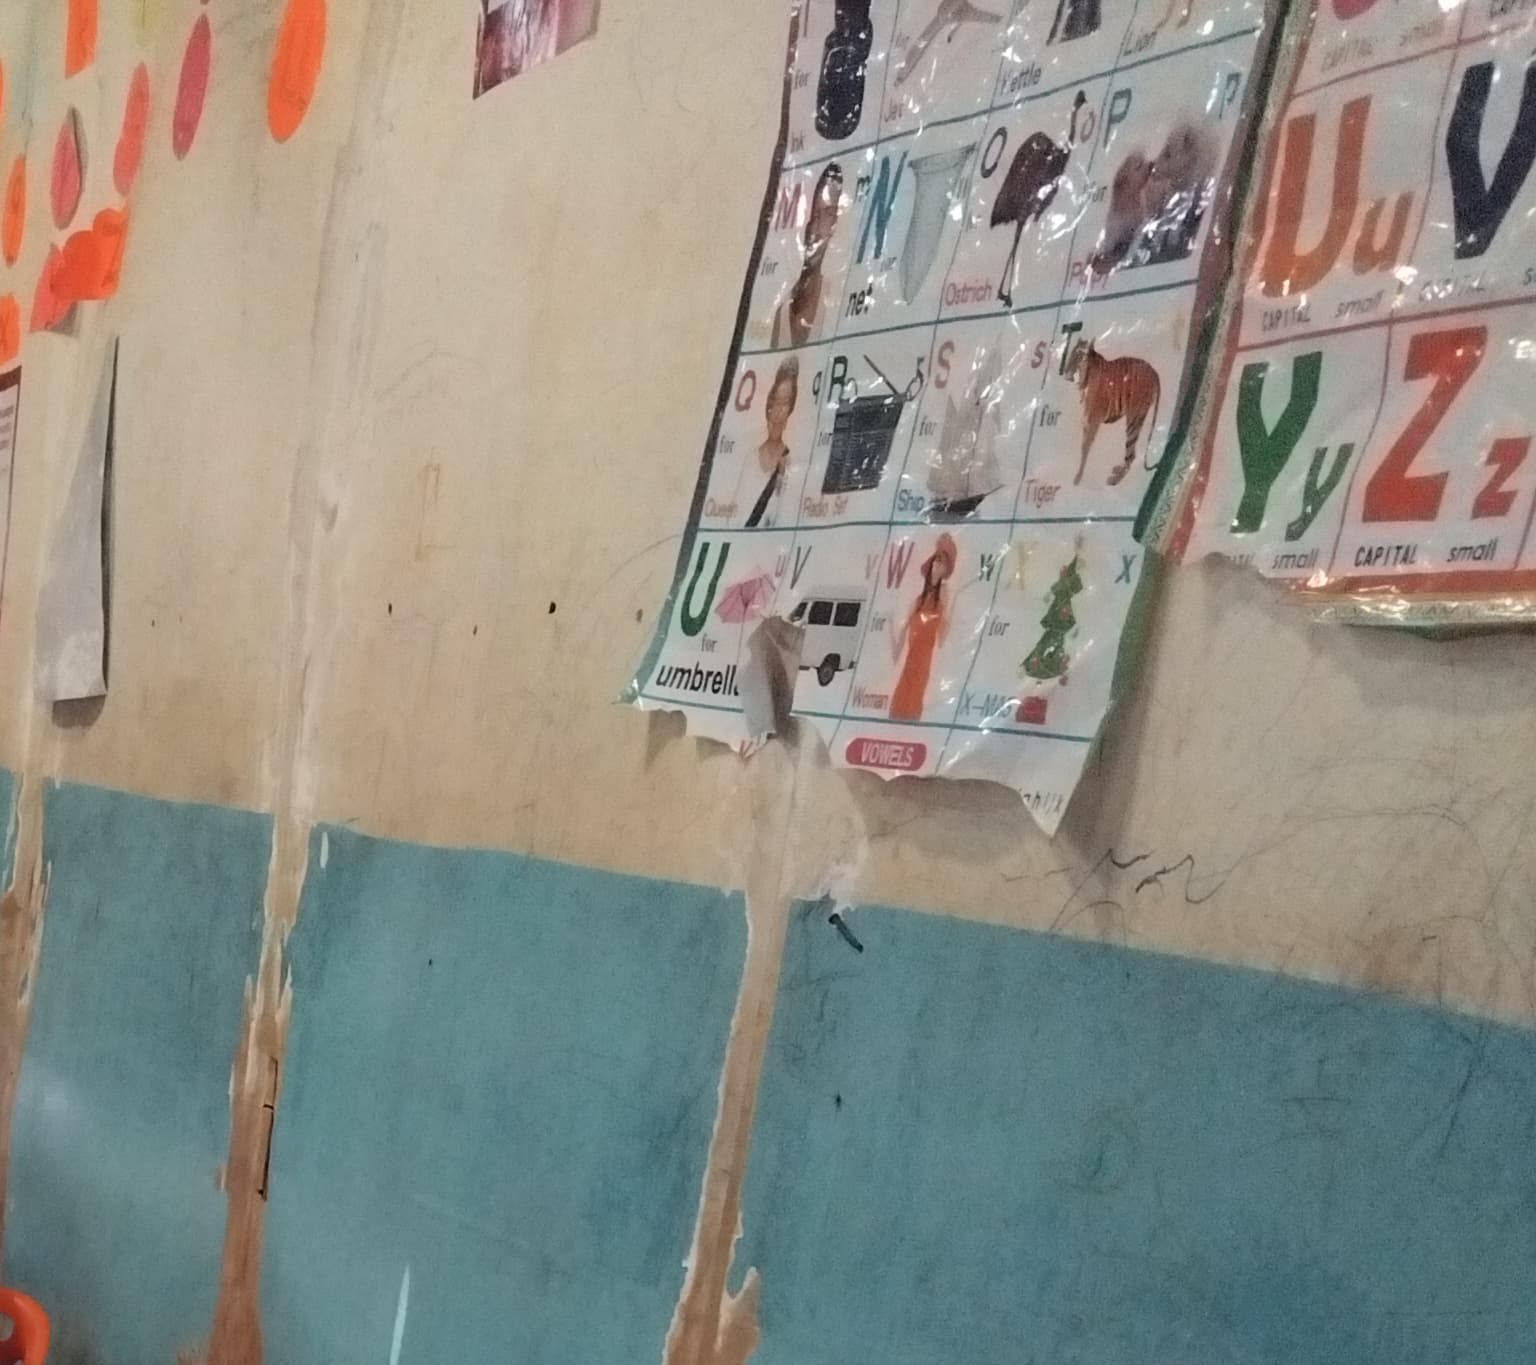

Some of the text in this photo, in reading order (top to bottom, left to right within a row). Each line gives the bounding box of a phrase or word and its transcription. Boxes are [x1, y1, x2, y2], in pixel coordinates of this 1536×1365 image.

[1103, 88, 1132, 148] P
[980, 126, 1008, 179] O
[944, 280, 993, 307] Ostrich
[933, 340, 956, 390] S
[734, 369, 757, 412] Q
[828, 355, 849, 405] R
[919, 416, 939, 437] for
[1038, 404, 1062, 428] for
[1023, 478, 1062, 509] Tiger
[886, 540, 914, 590] W
[1271, 548, 1319, 570] small
[1354, 544, 1418, 568] CAPITAL
[1446, 538, 1498, 563] small
[789, 545, 813, 590] V
[679, 541, 732, 638] U
[987, 613, 1011, 637] for
[701, 633, 718, 653] for
[860, 741, 915, 768] VOWELS
